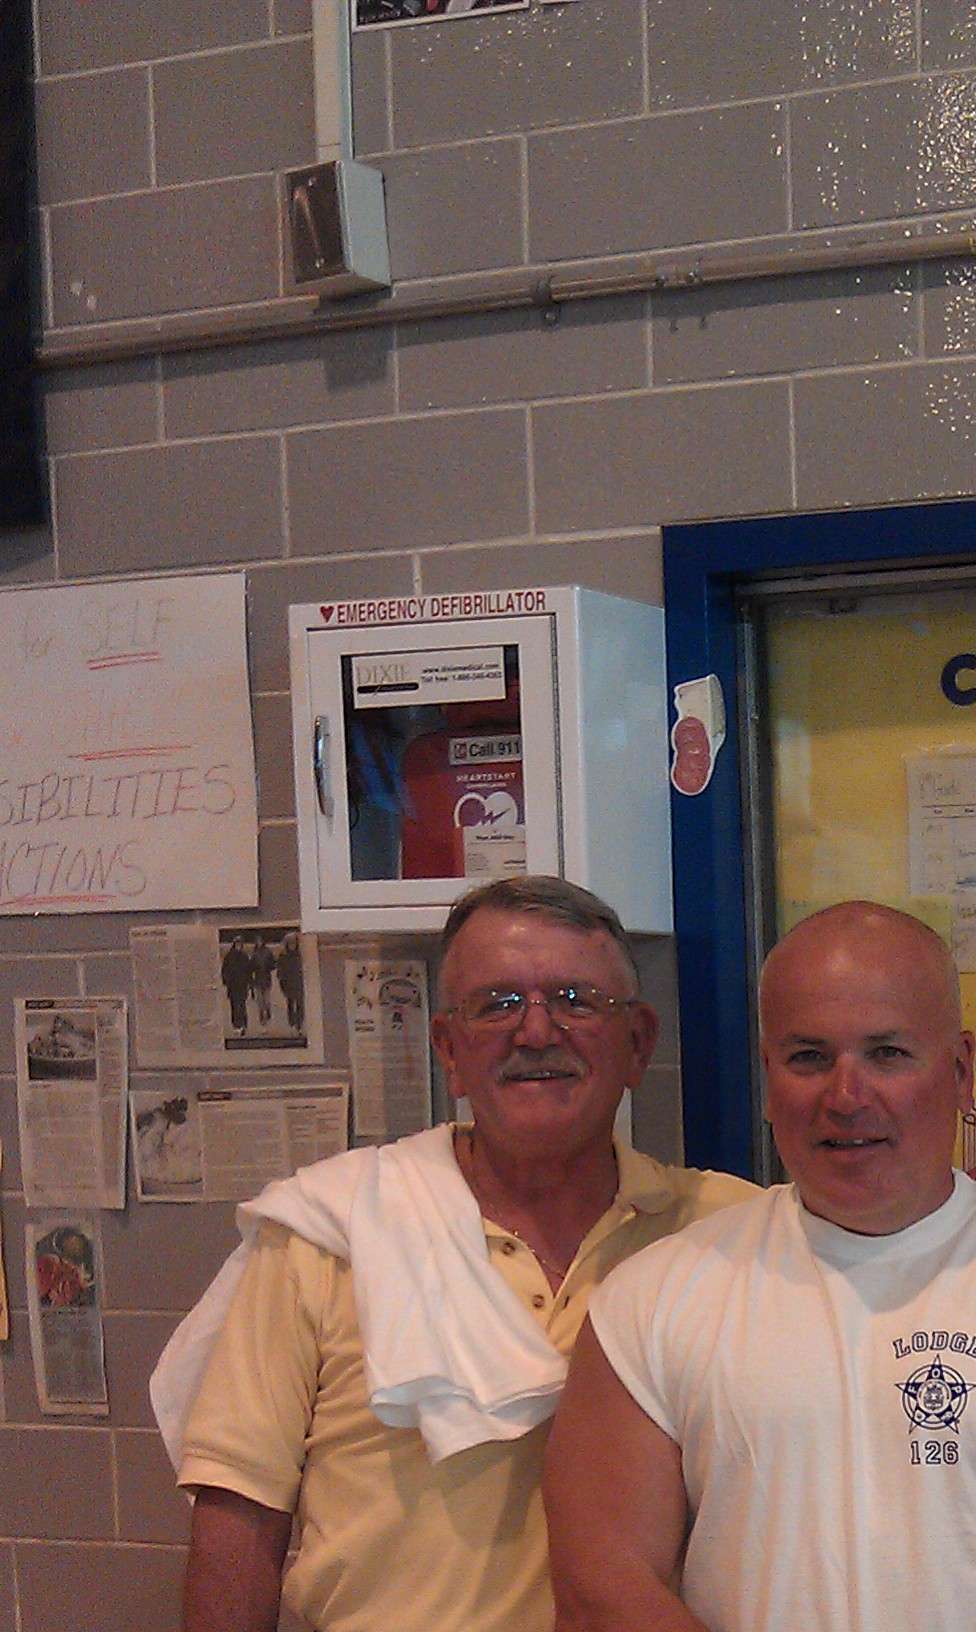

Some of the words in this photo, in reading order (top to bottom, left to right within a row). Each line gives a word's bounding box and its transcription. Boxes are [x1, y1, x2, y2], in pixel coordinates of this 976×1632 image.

[338, 597, 426, 623] EMERGENCY
[431, 591, 546, 618] DEFIBRILLATOR
[470, 742, 494, 757] Call
[499, 741, 520, 756] 911
[0, 764, 236, 826] IBILITIES
[0, 840, 147, 898] CTIONS
[911, 1440, 959, 1465] 126
